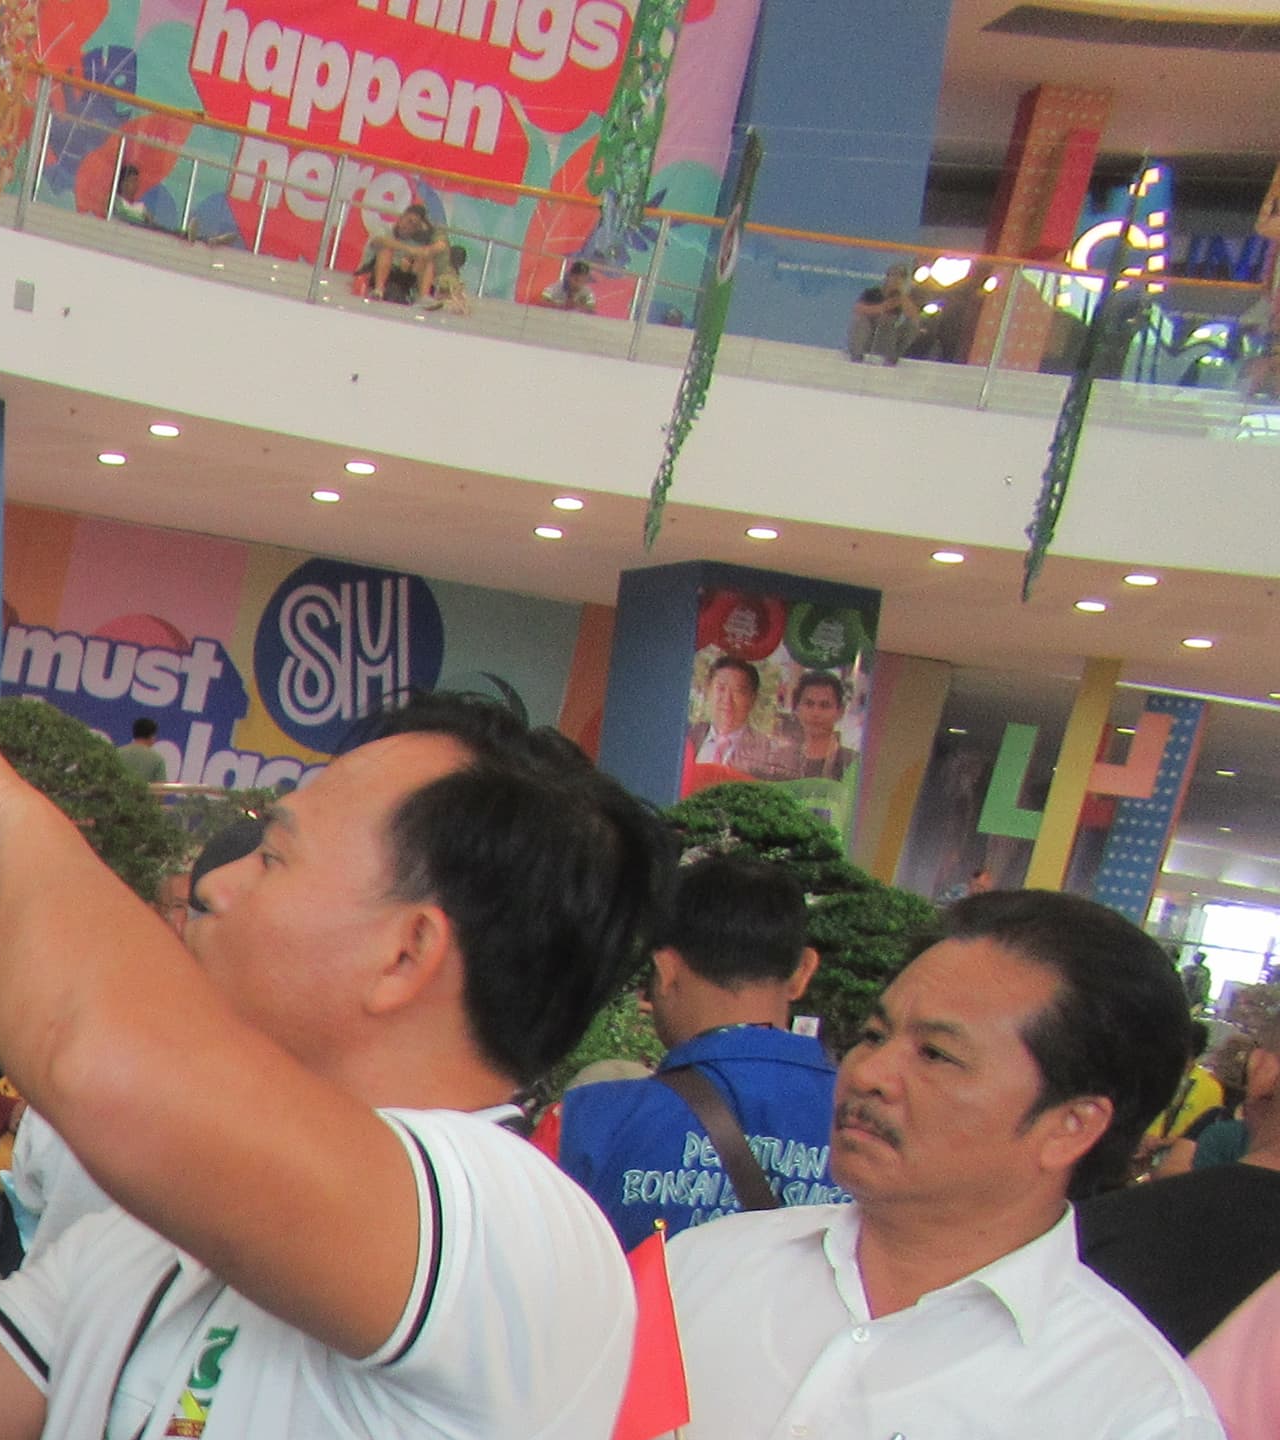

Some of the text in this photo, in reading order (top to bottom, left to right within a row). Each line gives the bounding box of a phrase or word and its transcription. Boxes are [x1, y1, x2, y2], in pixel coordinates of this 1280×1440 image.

[192, 0, 504, 155] happen
[230, 101, 412, 240] here
[1, 626, 223, 713] must
[278, 576, 409, 726] SM
[622, 1169, 721, 1206] BONSAI
